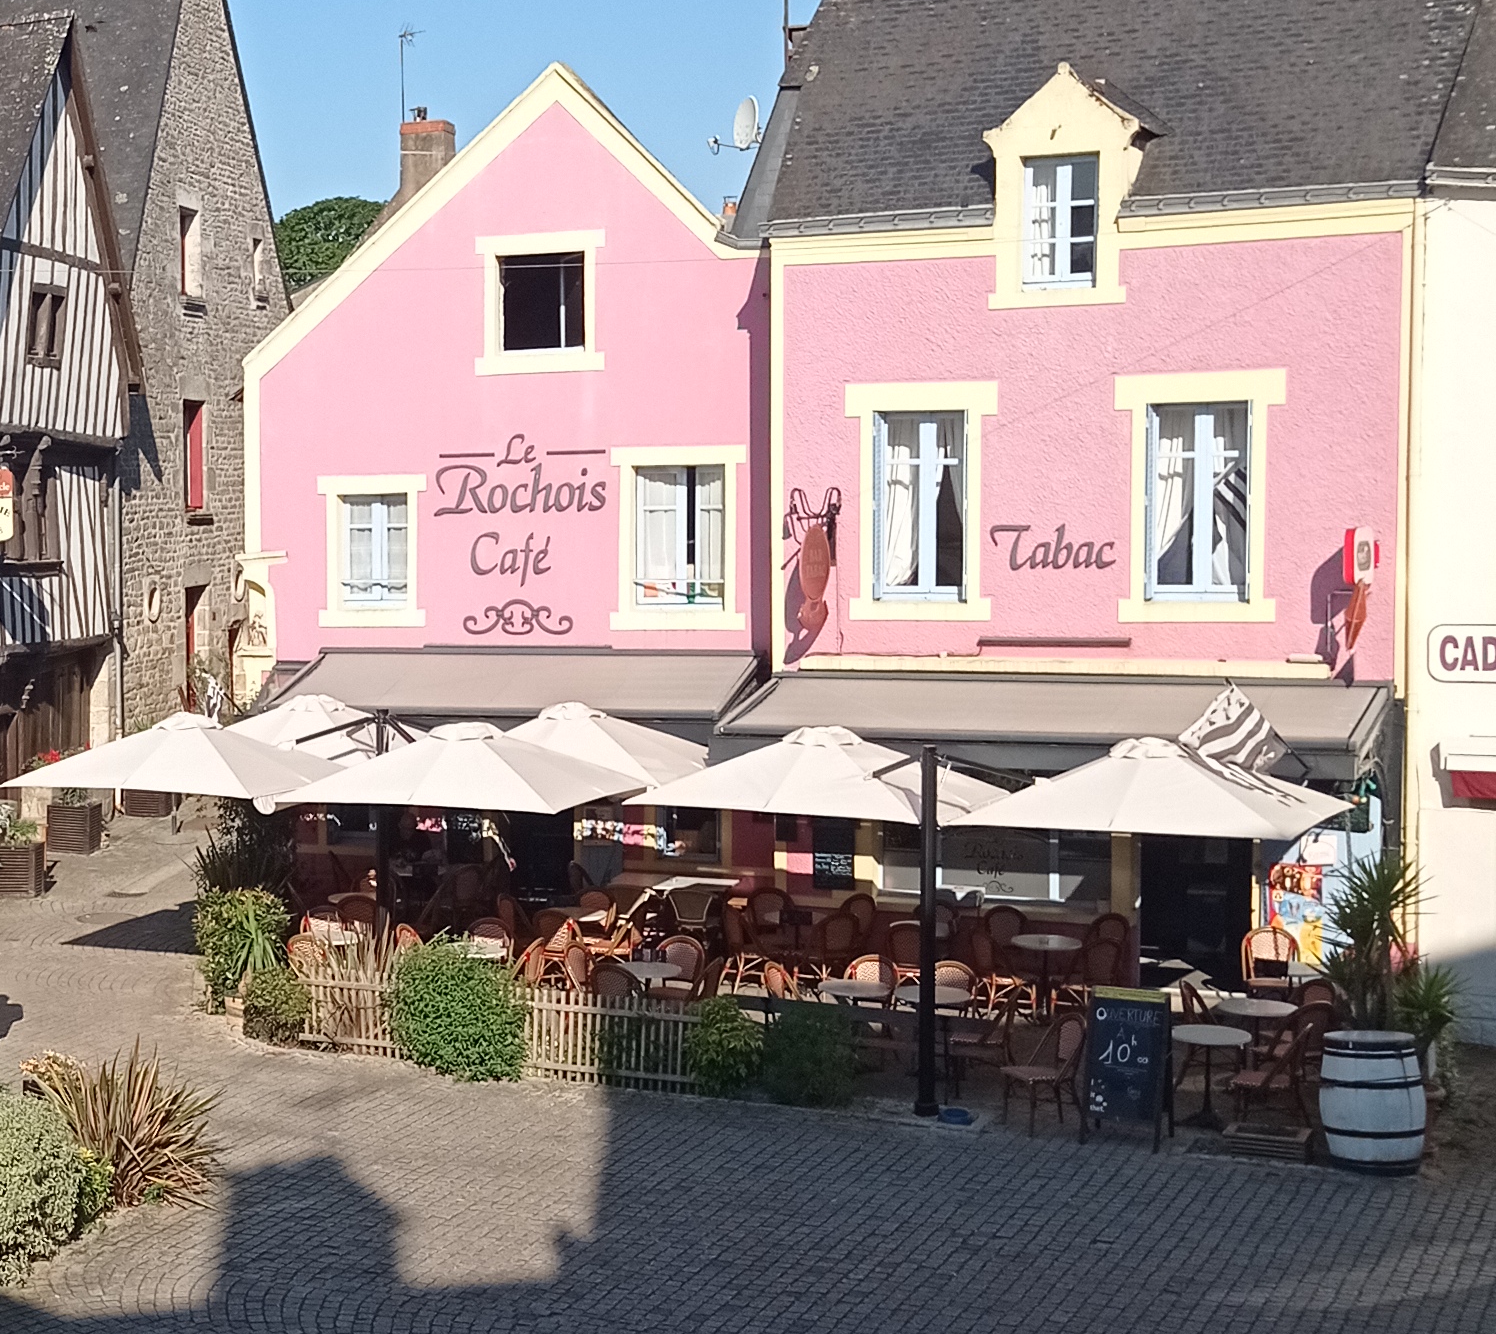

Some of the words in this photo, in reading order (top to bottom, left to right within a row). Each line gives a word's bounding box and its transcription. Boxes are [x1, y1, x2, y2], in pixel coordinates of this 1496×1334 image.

[496, 433, 536, 467] Le
[433, 462, 606, 517] Rochois
[470, 531, 551, 587] Café
[989, 523, 1116, 571] Tabac
[1439, 634, 1496, 672] CAD
[1096, 1007, 1164, 1026] OUVERTURE
